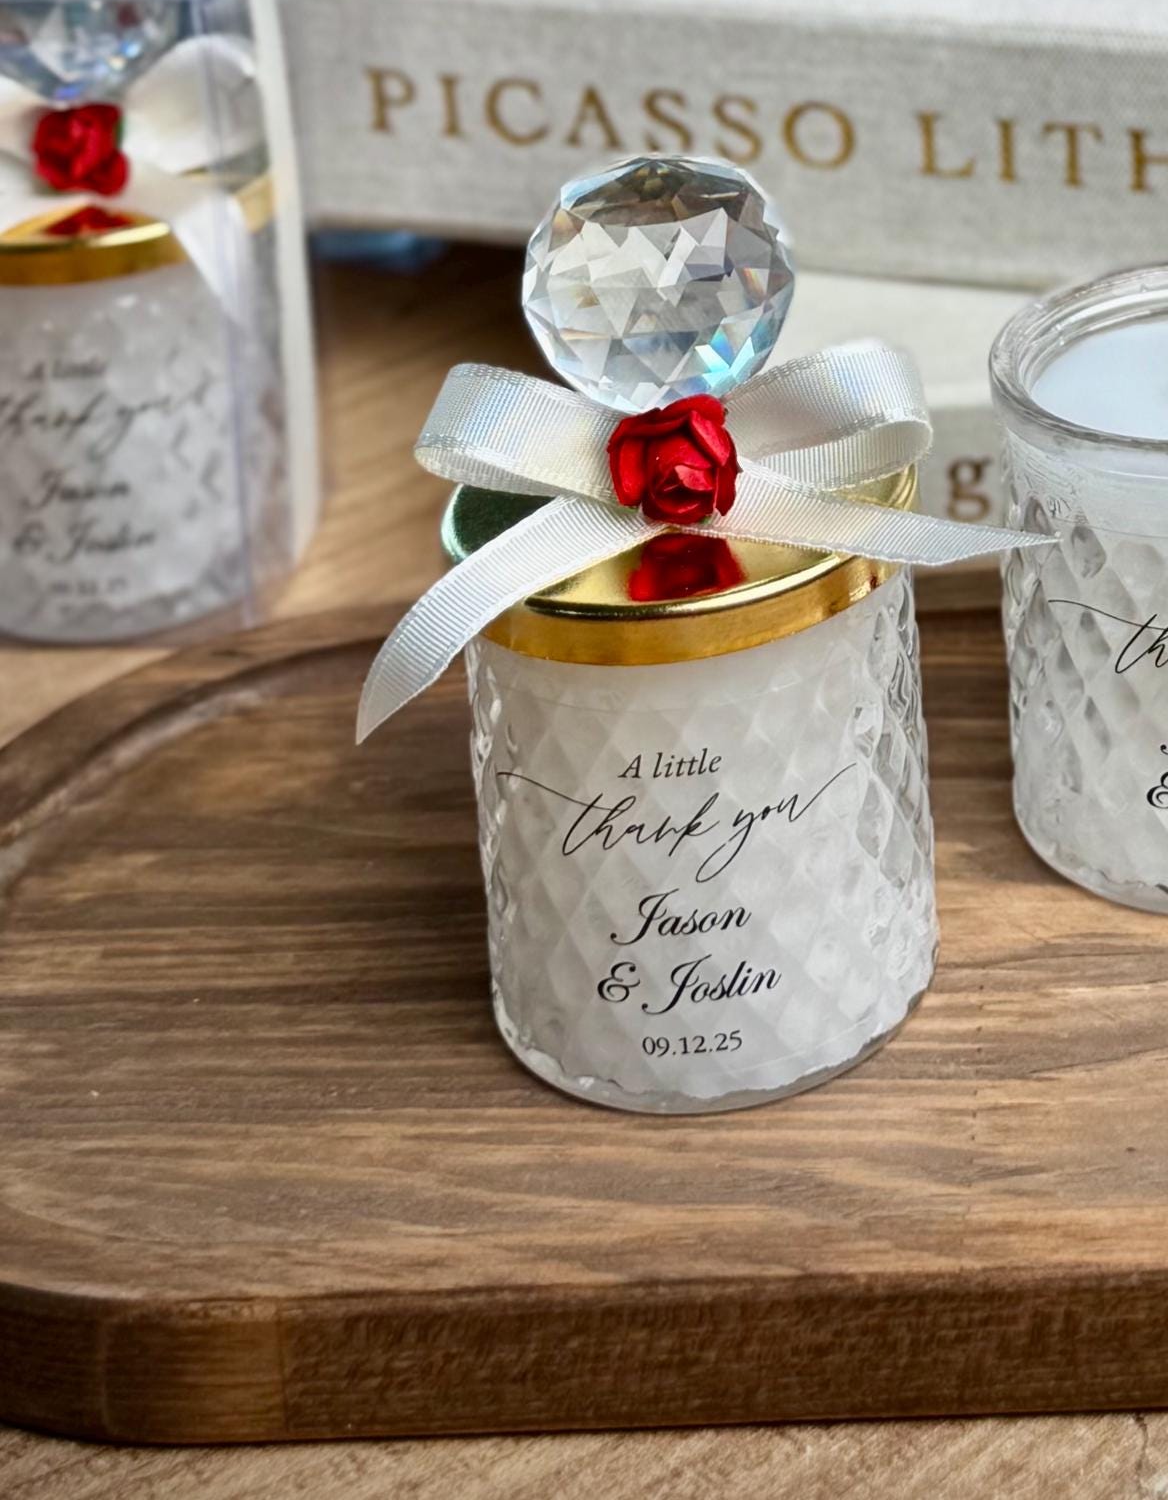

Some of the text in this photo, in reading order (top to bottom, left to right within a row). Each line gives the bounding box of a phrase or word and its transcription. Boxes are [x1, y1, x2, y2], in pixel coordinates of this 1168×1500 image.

[364, 68, 857, 170] PICASSO
[617, 747, 723, 780] A little
[496, 762, 858, 884] thank you
[609, 887, 753, 946] Jason
[596, 953, 783, 1016] & Joslin
[641, 1029, 744, 1058] 09.12.25
